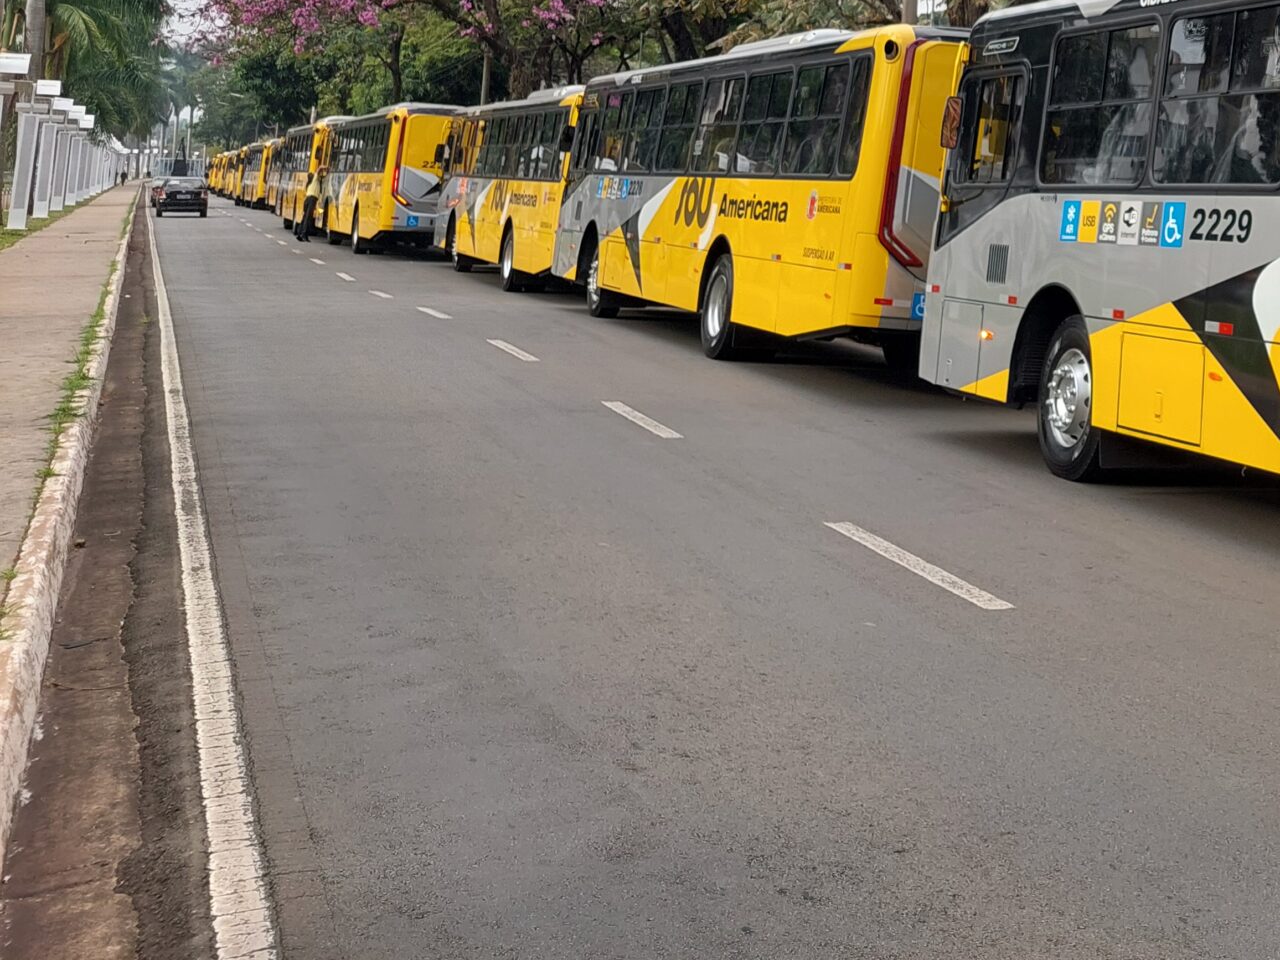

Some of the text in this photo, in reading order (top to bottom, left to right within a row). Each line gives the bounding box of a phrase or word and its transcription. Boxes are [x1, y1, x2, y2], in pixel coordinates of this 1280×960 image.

[718, 193, 788, 224] Americana
[1082, 215, 1096, 227] USB
[1102, 223, 1115, 234] GPS
[1189, 208, 1253, 244] 2229
